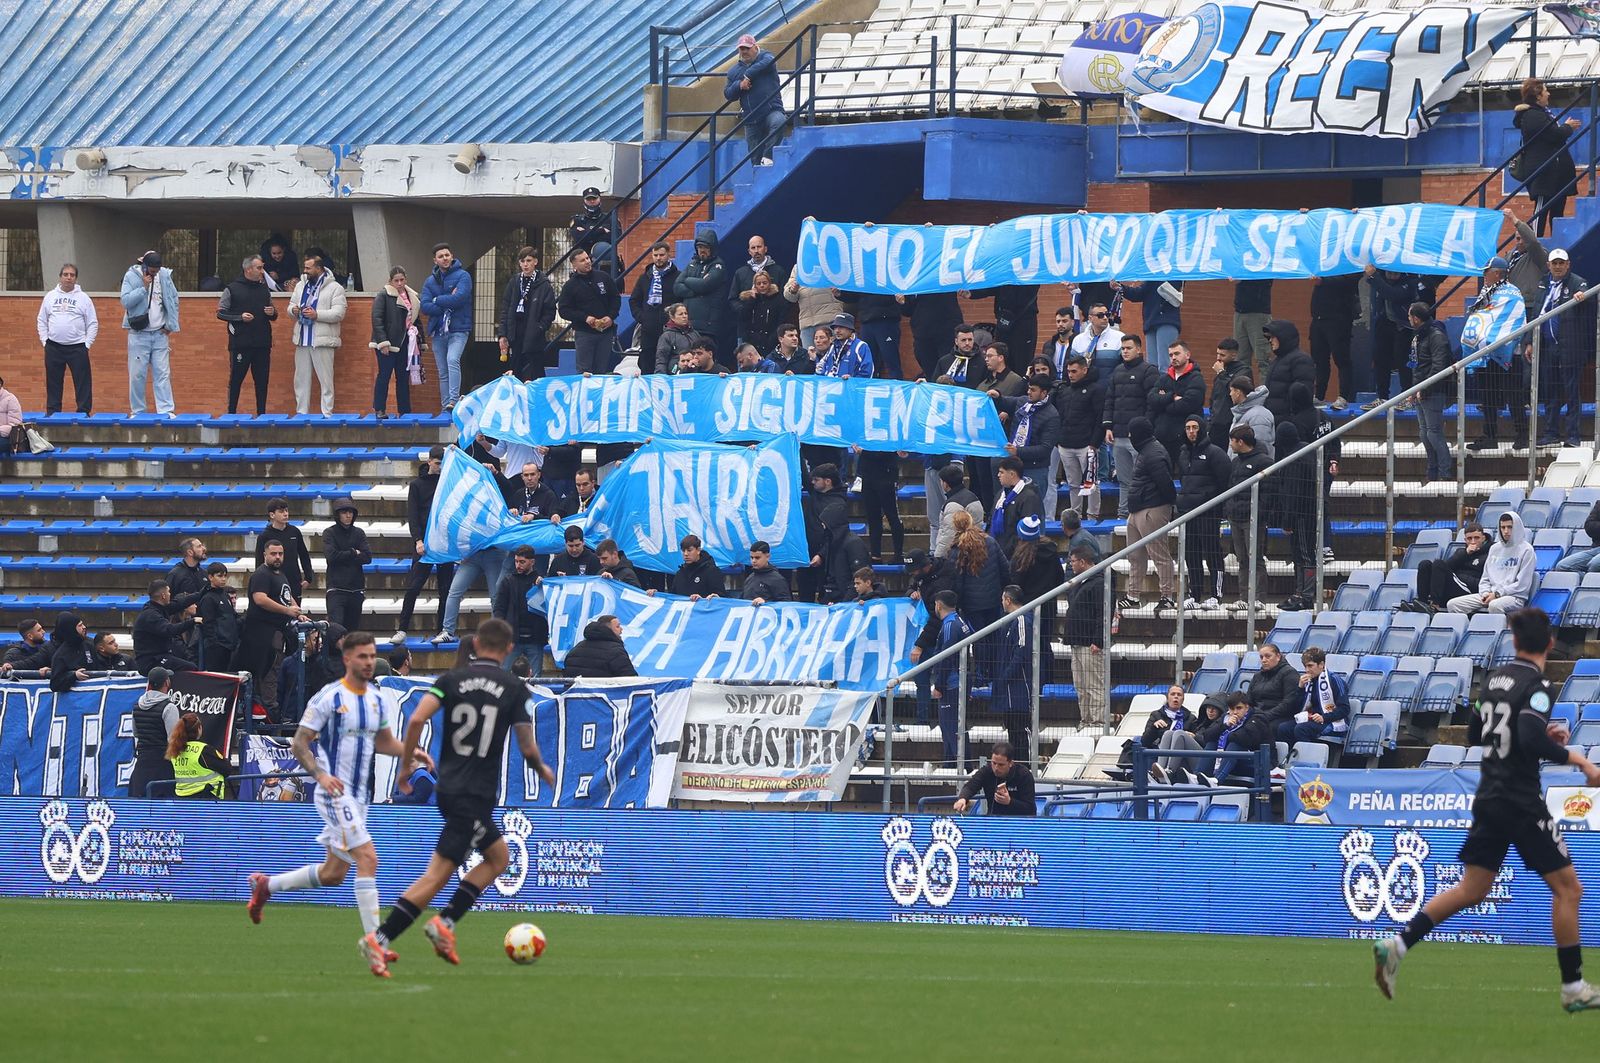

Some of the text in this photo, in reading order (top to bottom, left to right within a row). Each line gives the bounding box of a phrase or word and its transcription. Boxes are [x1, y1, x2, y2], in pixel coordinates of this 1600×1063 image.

[797, 206, 1478, 290] COMO EL JUNCO QUE SE DOBLA
[545, 377, 696, 440] SIEMPRE
[714, 375, 843, 439] SIGUE
[863, 382, 911, 442] EN
[924, 389, 999, 448] PIE
[629, 448, 790, 555] JAIRO
[451, 703, 499, 758] 21
[725, 693, 804, 716] SECTOR
[1480, 701, 1512, 759] 23
[687, 775, 725, 788] DECANO
[728, 778, 745, 790] DEL
[1349, 789, 1395, 810] PEÑA
[343, 806, 353, 821] 6
